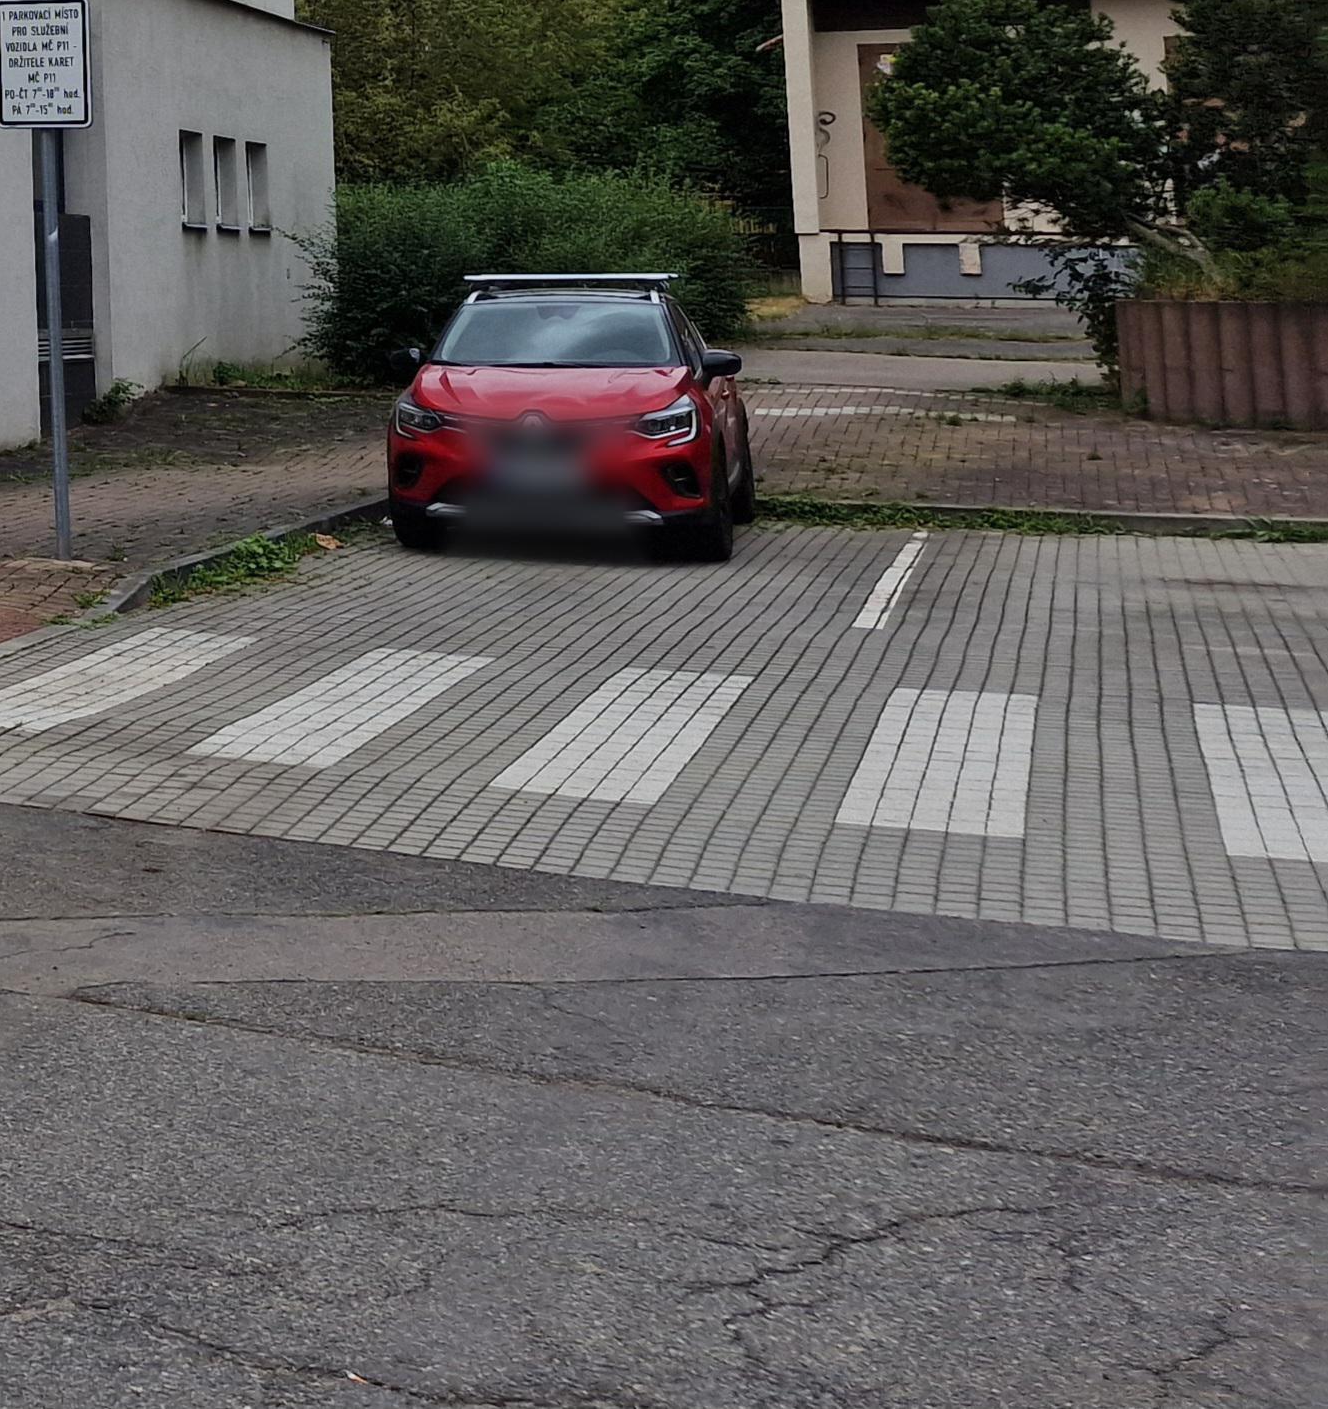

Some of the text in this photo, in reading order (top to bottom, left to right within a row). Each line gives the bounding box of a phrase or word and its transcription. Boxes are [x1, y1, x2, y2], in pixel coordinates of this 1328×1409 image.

[9, 8, 51, 20] PARKOVACÍ
[55, 7, 79, 19] MÍSTO
[12, 22, 69, 36] PRO SLUŽEBNÍ
[5, 42, 38, 52] VOZIDLA
[41, 39, 53, 51] MČ
[57, 41, 69, 51] P11
[8, 55, 74, 68] DRŽITELE KARET
[28, 71, 56, 83] MČ P11
[4, 87, 28, 99] PO-ČT
[12, 102, 22, 115] PÁ
